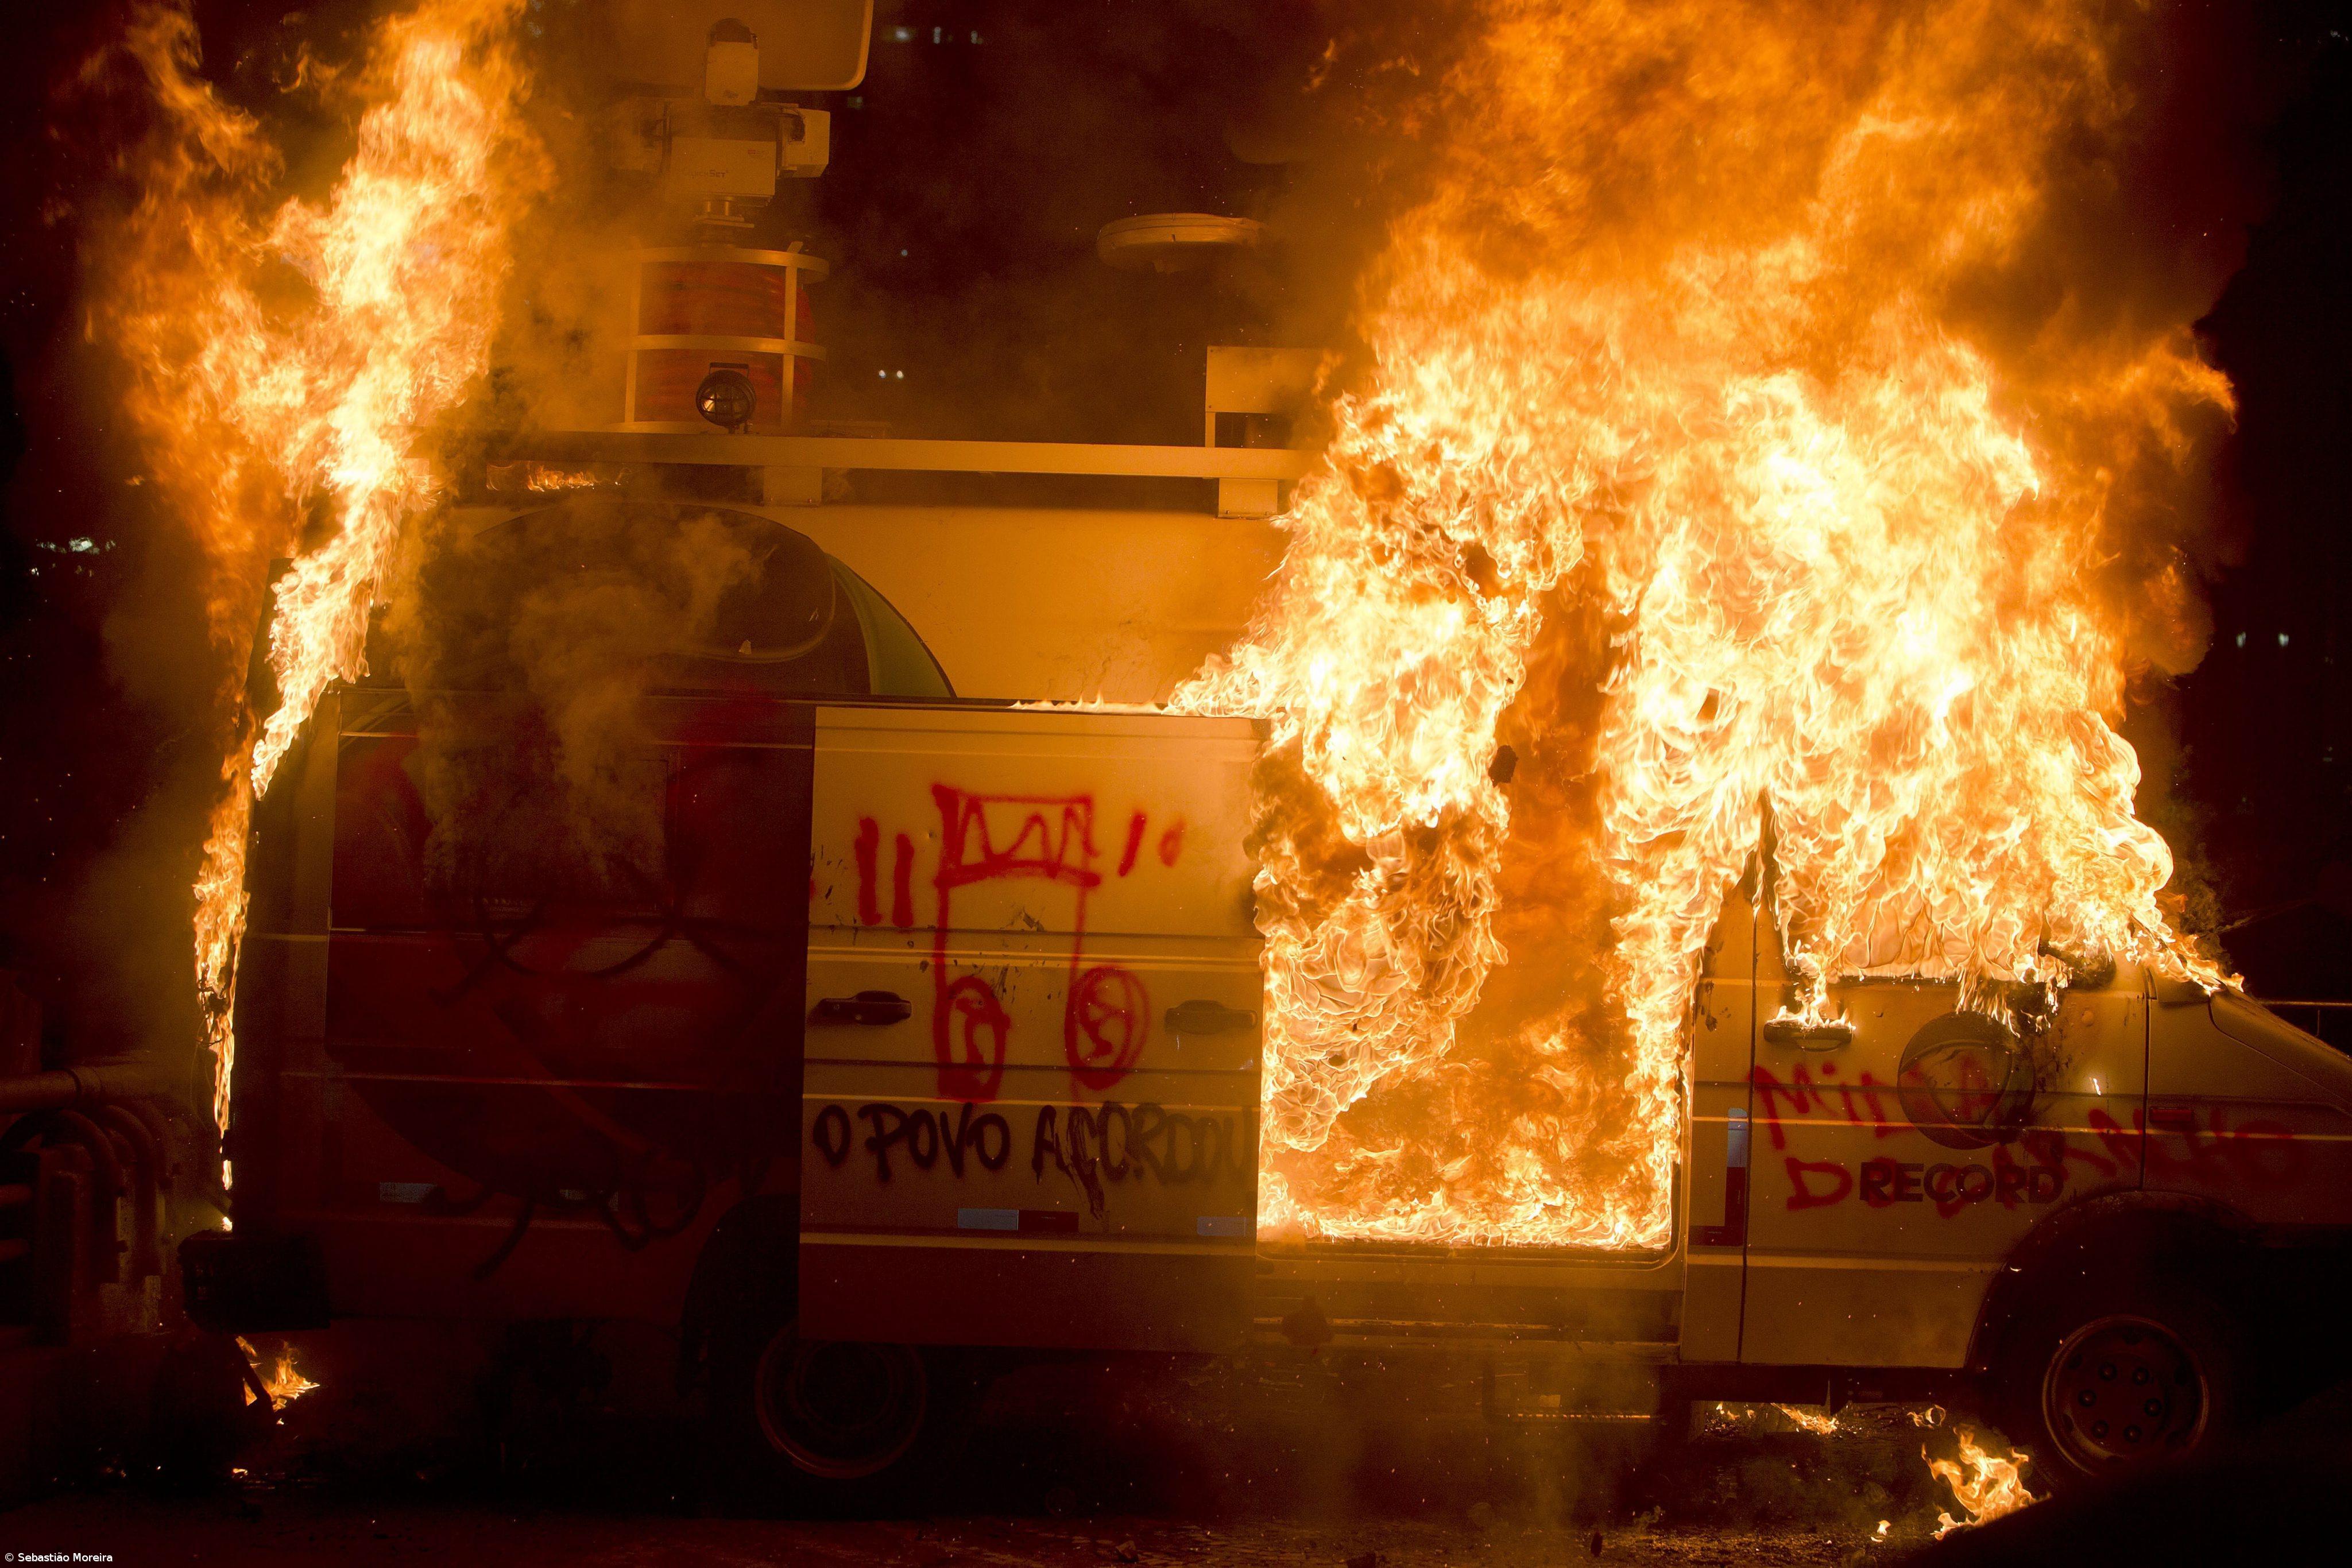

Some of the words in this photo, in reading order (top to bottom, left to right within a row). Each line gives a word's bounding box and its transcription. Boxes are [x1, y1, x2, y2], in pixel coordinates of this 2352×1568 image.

[813, 1104, 852, 1169] O
[858, 1102, 1011, 1182] POVO
[1859, 1161, 2065, 1205] RECORD
